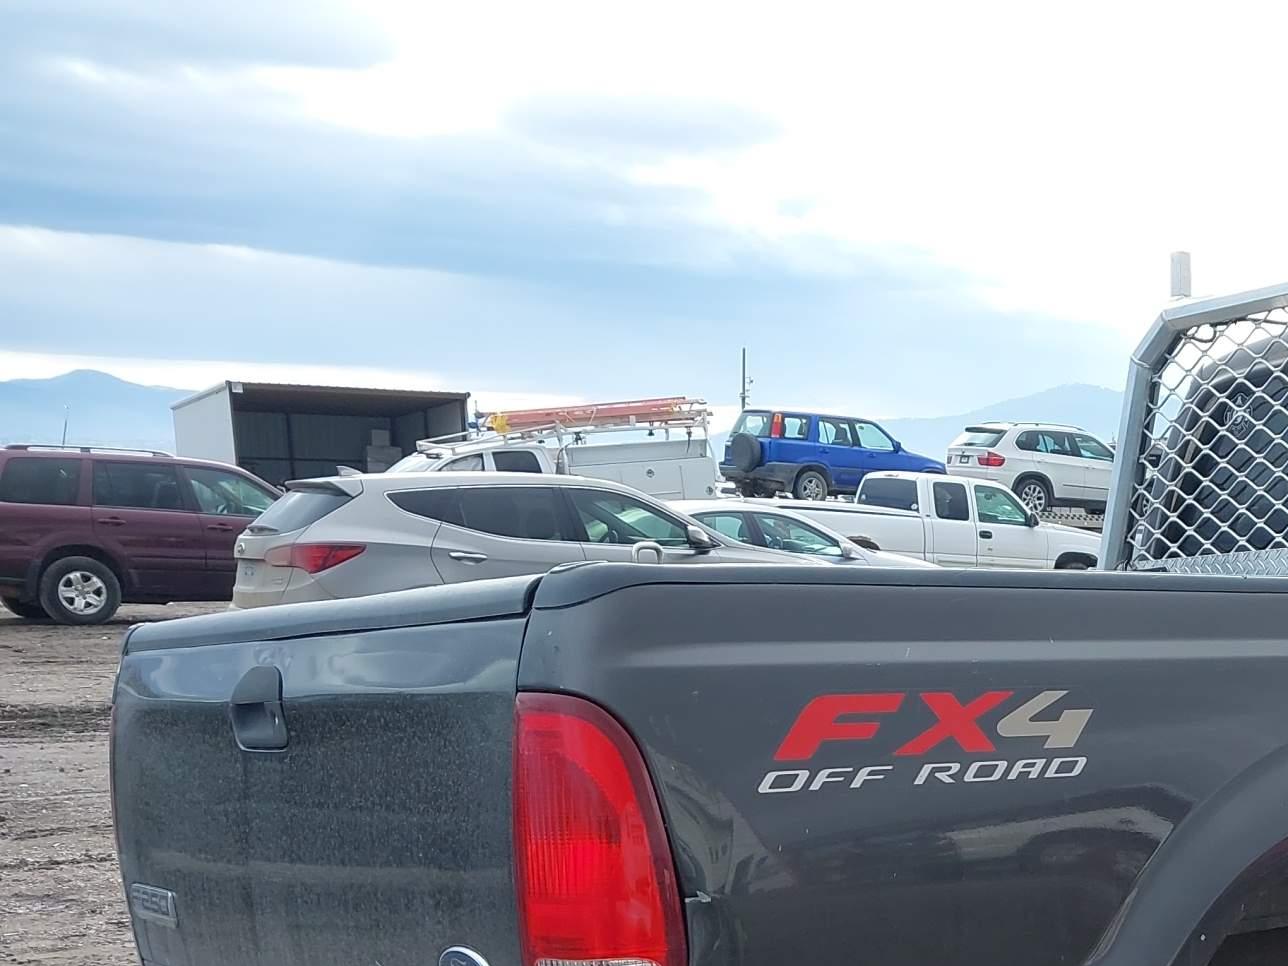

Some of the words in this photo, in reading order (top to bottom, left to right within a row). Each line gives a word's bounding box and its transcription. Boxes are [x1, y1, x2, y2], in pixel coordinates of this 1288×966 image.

[773, 690, 1094, 761] FX4
[757, 765, 893, 794] OFF
[913, 756, 1087, 785] ROAD
